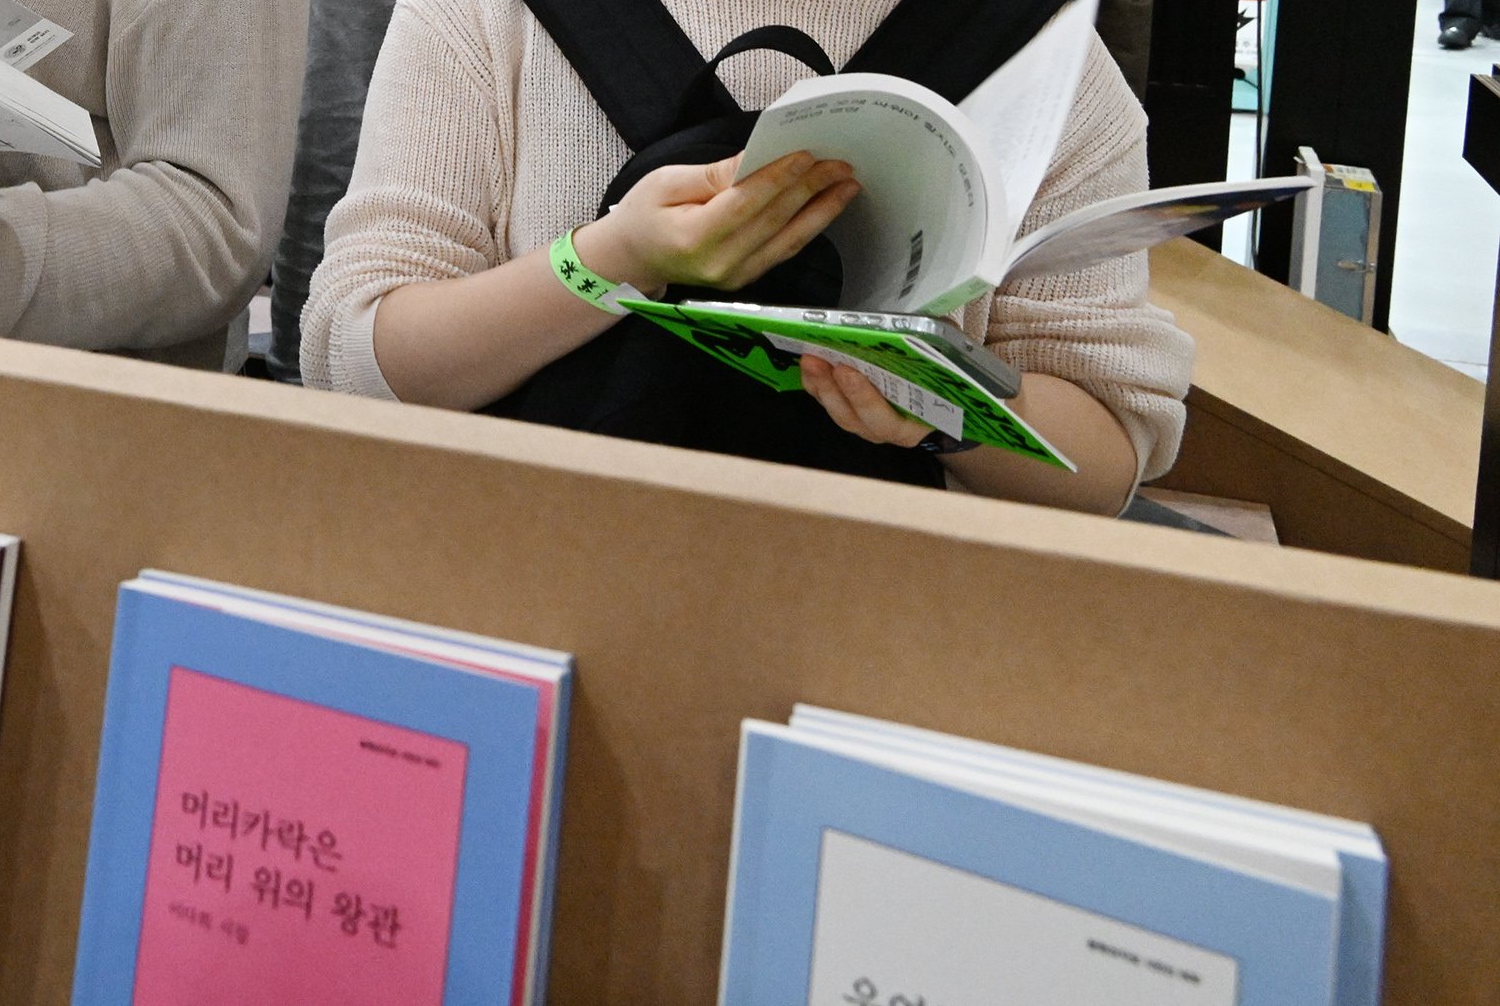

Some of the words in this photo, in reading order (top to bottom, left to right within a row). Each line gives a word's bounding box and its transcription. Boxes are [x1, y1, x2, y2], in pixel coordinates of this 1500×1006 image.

[182, 790, 343, 873] 머리카락은
[175, 842, 234, 893] 머리
[251, 866, 315, 922] 위의
[331, 891, 402, 950] 왕관
